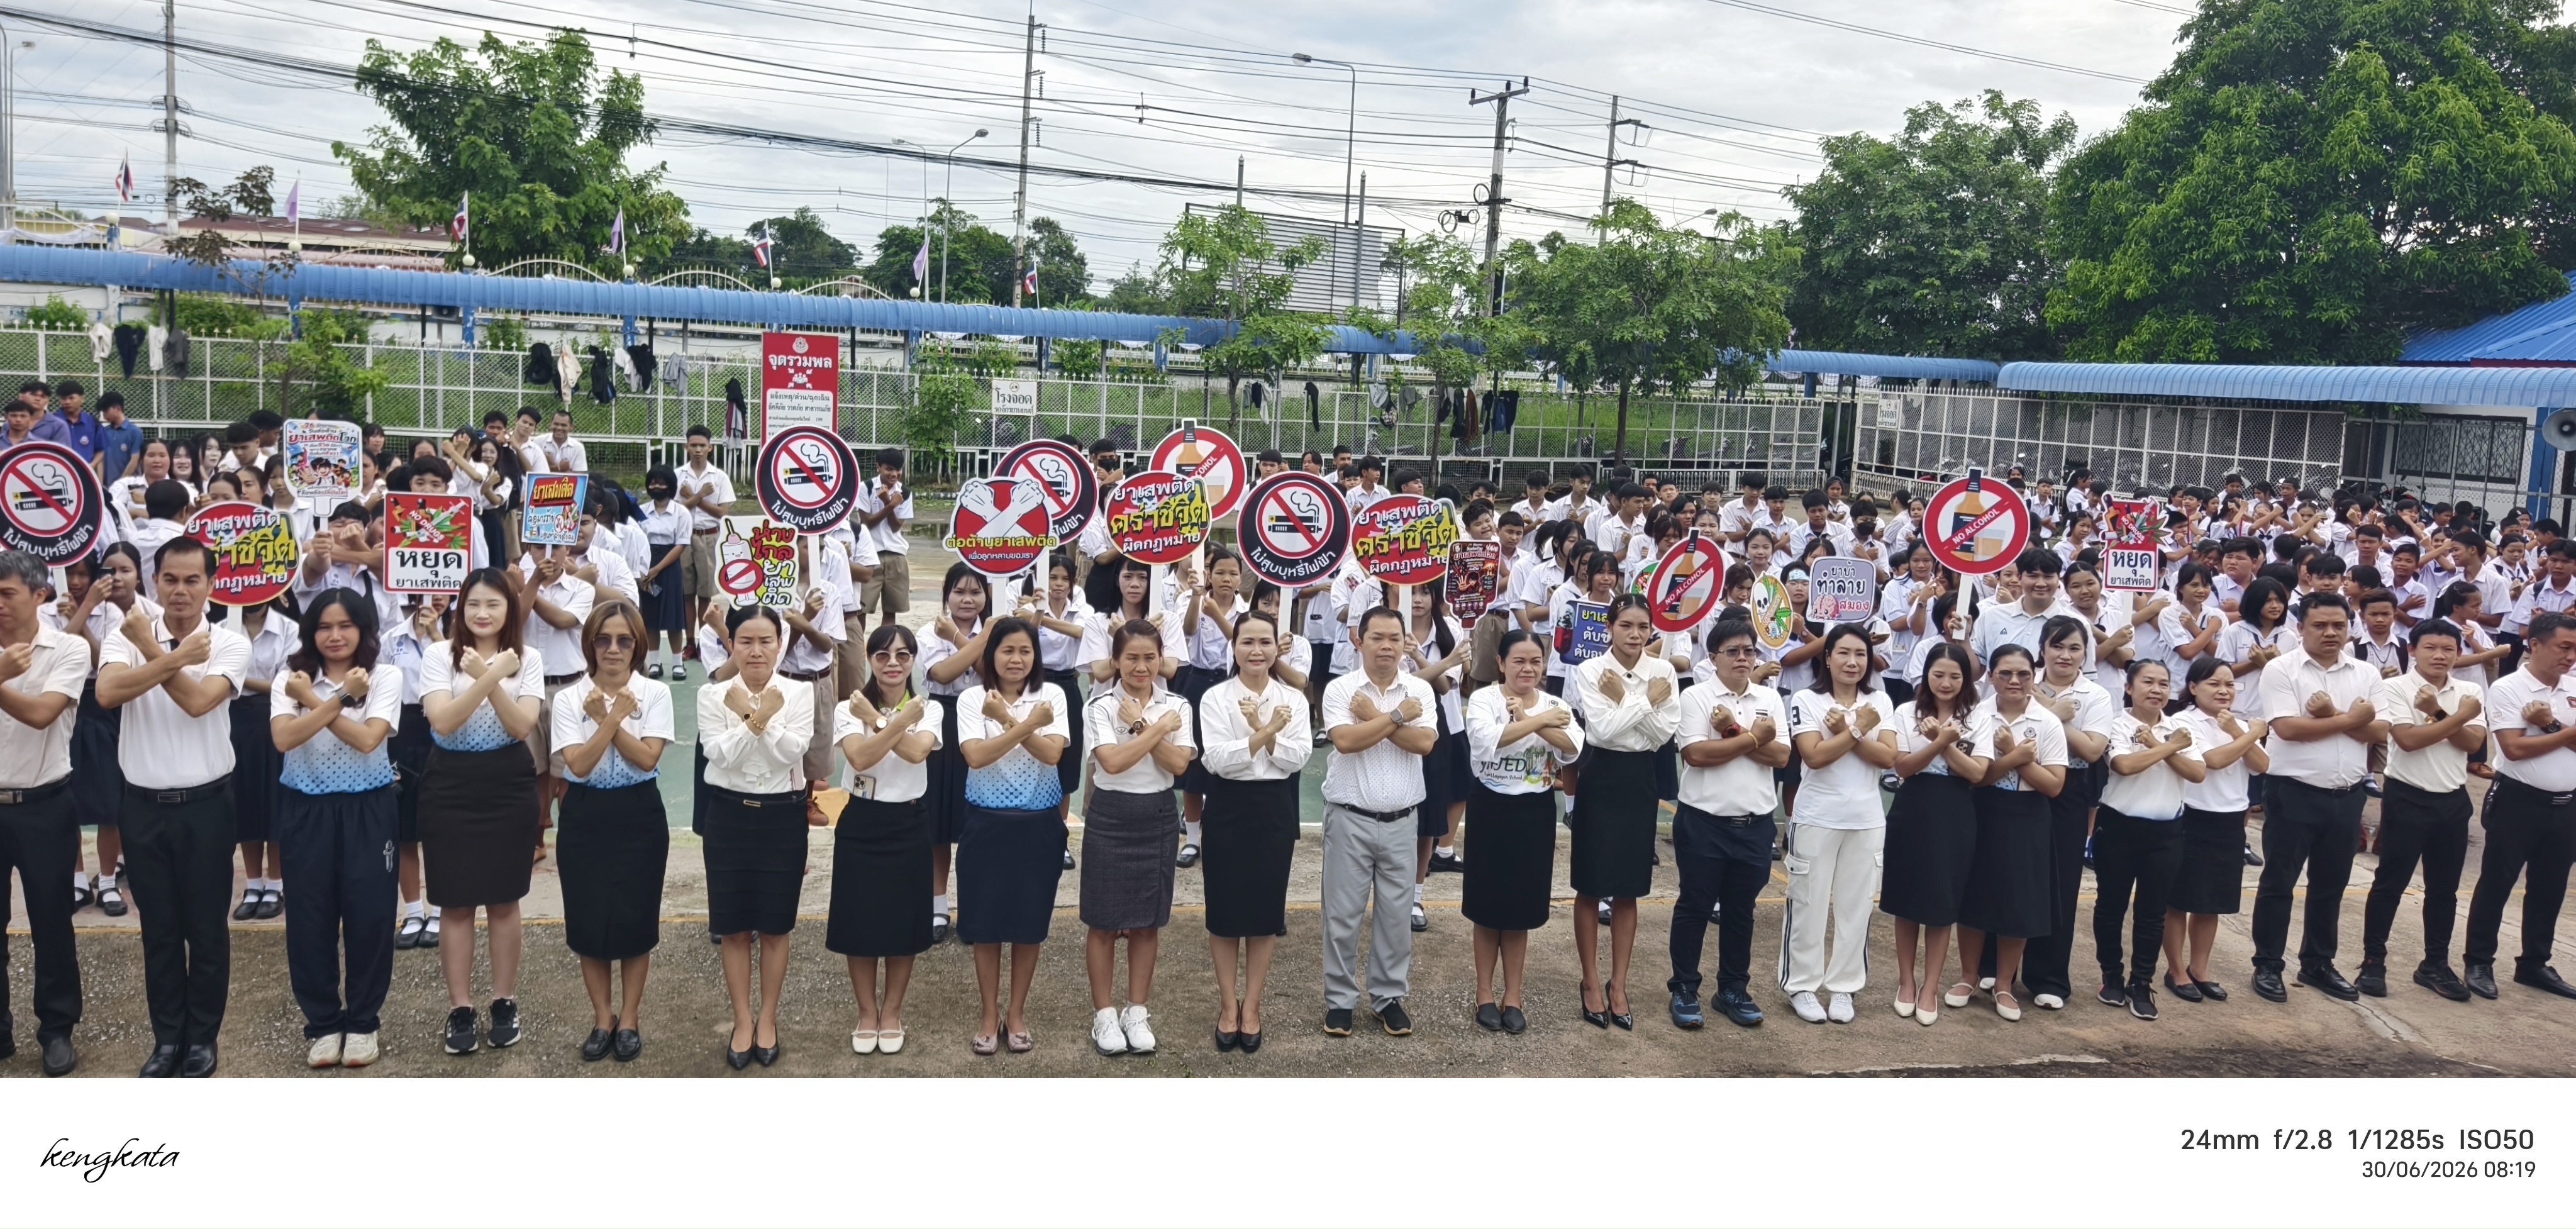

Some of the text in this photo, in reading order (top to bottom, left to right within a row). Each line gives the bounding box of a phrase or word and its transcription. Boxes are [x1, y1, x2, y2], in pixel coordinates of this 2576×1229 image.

[769, 355, 832, 370] จุดรวมพล
[995, 387, 1032, 404] โรงจอด
[1195, 456, 1218, 477] COHOL
[533, 477, 574, 500] ยาเสพติด
[1114, 476, 1195, 501] ยาเสพติด
[188, 508, 280, 533] ยาเสพติด
[1111, 484, 1208, 536] คร่าชีวิต
[1358, 499, 1442, 525] ยาเสพติด
[409, 510, 445, 541] NO DRUGS
[753, 520, 796, 543] ห่าง
[1356, 506, 1457, 559] คร่าชีวิต
[1952, 509, 2000, 544] NO ALCOHOL
[2121, 516, 2145, 542] NO DRUGS
[3, 524, 93, 560] ไม่สบบุหรี่ไฟฟ้า
[751, 538, 796, 561] ไกล
[396, 550, 462, 578] หยุด
[969, 550, 1033, 560] เพื่อลูกหลานของเรา
[1251, 545, 1336, 579] ไม่สูบบุหรี่ไฟฟ้า
[2112, 552, 2151, 577] หยุด
[763, 559, 796, 578] ยา
[1831, 560, 1855, 577] ยาบ้า
[2111, 574, 2151, 586] ยาเสพติด
[215, 572, 287, 592] กฎหมาย
[396, 576, 461, 588] ยาเสพติด
[764, 574, 795, 589] เสพ
[1665, 568, 1705, 605] NO ALCOHOL
[1817, 572, 1865, 594] ทำลาย
[762, 587, 792, 605] ติด
[1840, 599, 1869, 610] สมอง
[1582, 609, 1607, 622] ยาเส
[1574, 643, 1602, 659] ดับอ
